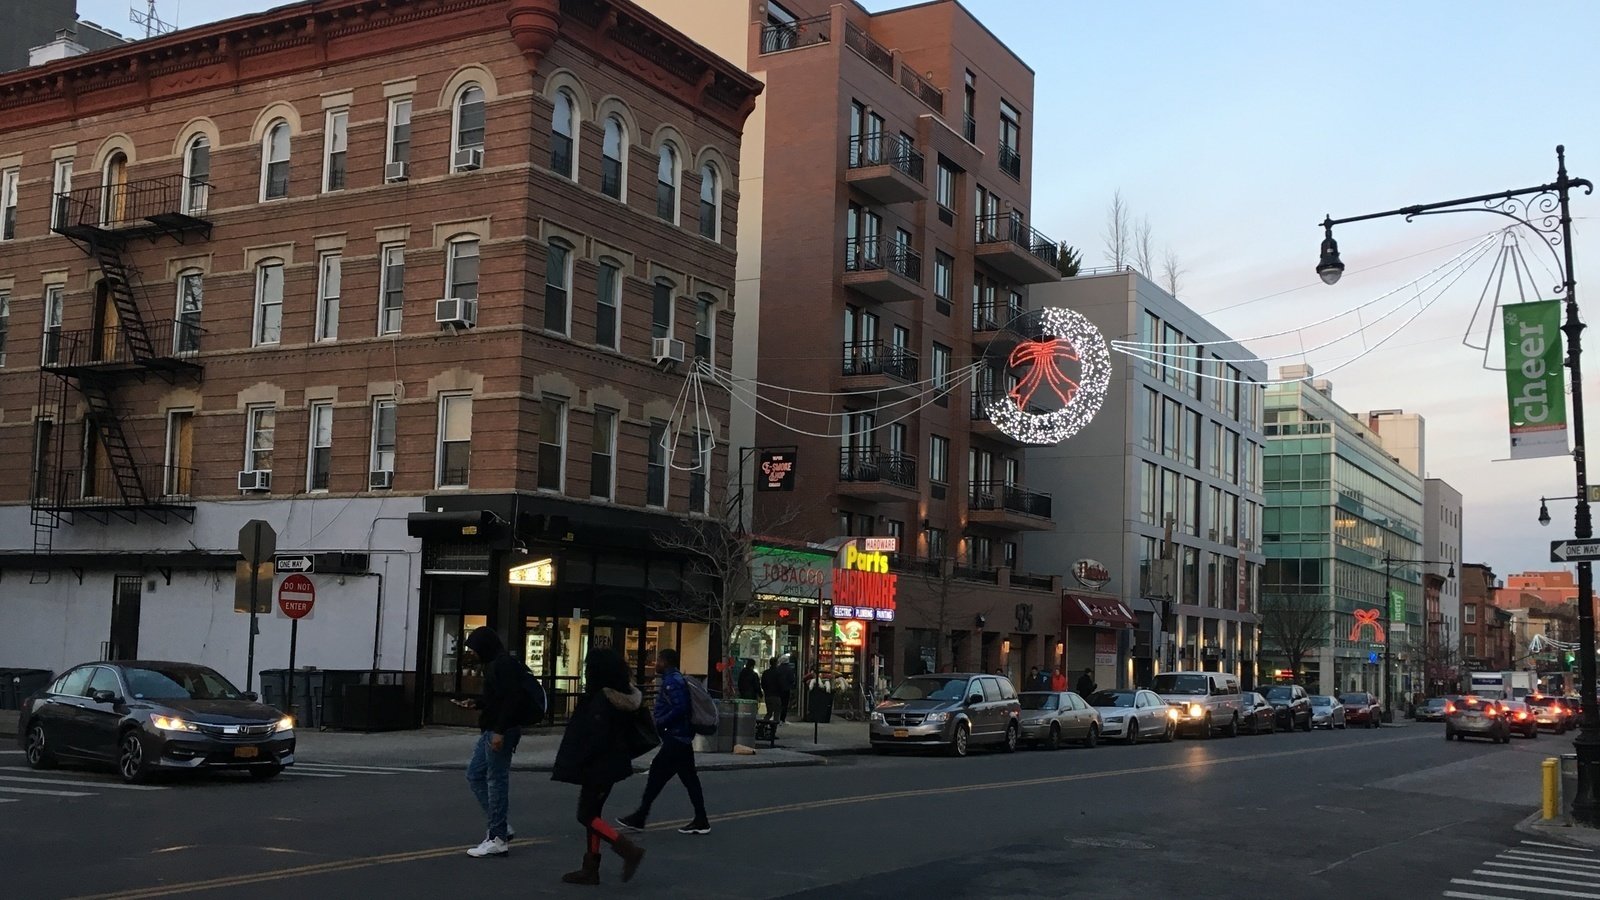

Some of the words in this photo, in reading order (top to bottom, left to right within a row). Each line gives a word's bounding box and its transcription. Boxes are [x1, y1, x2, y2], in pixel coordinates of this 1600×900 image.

[1513, 321, 1549, 423] cheer
[866, 539, 895, 550] HARDWARE
[1566, 546, 1581, 555] ONE
[1583, 545, 1599, 554] WAY
[280, 560, 291, 568] ONE
[292, 560, 303, 568] WAY
[847, 545, 888, 574] Parts
[763, 562, 824, 585] TOBACCO
[284, 582, 294, 590] DO
[297, 583, 310, 591] NOT
[832, 567, 897, 610] HARDWARE
[285, 602, 307, 610] ENTER
